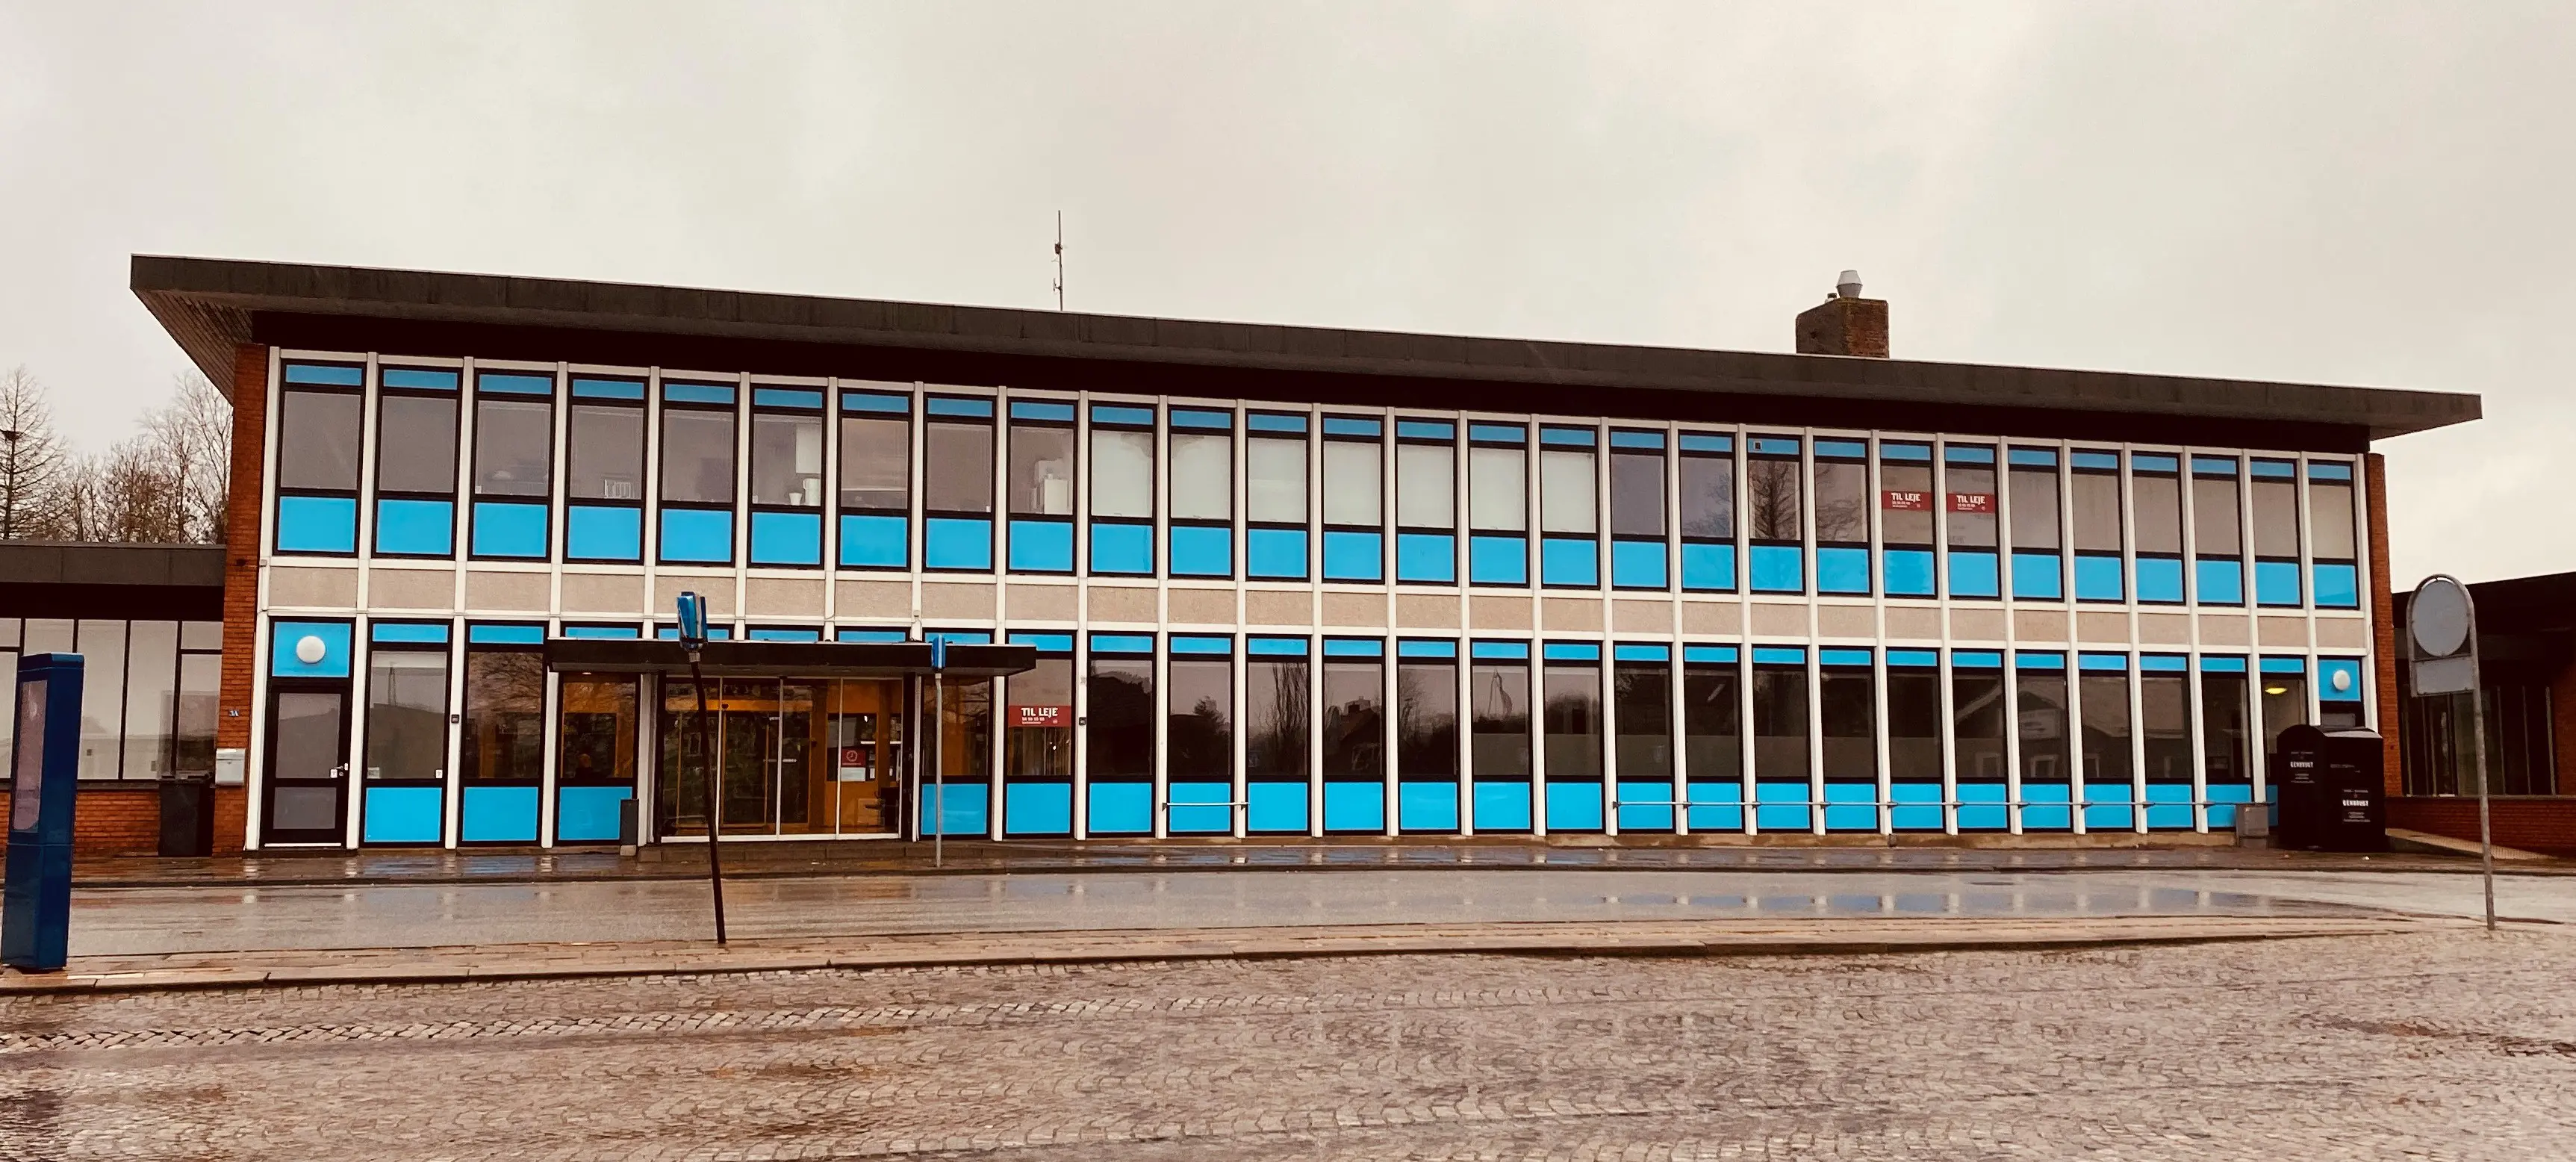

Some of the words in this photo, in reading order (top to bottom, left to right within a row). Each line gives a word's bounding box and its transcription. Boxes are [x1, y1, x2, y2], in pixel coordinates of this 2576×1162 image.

[1891, 493, 1903, 501] TIL
[1905, 493, 1920, 503] LEJE
[1956, 494, 1968, 503] TIL
[1970, 495, 1985, 505] LEJE
[1021, 707, 1036, 717] TIL
[1039, 707, 1058, 718] LEJE
